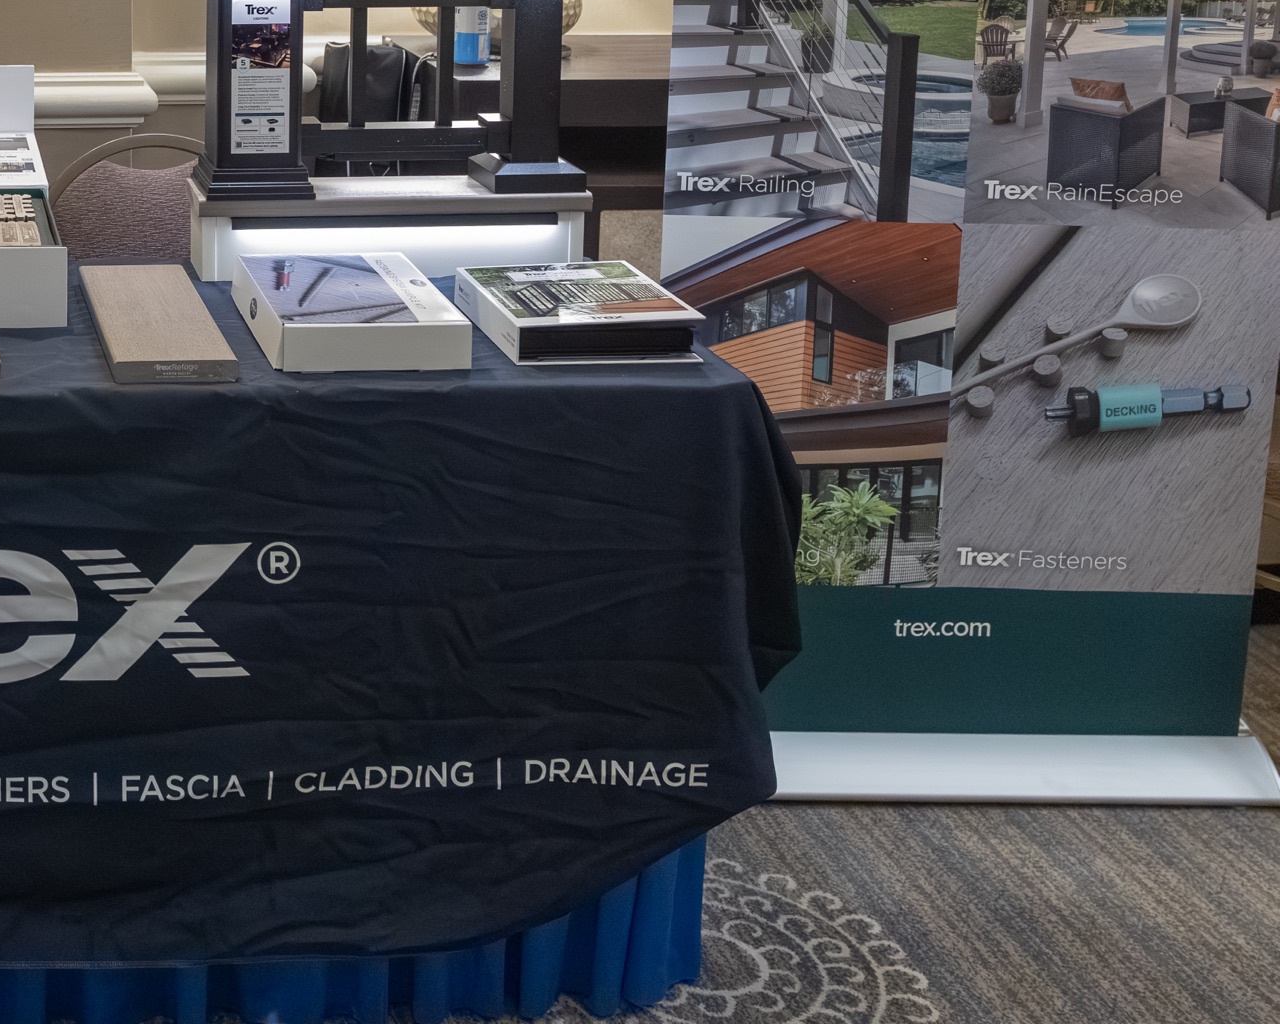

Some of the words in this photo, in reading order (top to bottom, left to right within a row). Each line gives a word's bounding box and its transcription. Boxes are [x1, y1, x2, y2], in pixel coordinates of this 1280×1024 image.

[245, 4, 274, 15] Trex
[740, 174, 816, 198] Railing
[1047, 182, 1183, 206] RainEscape
[1106, 404, 1157, 418] DECKING
[1019, 550, 1127, 570] Fasteners
[894, 619, 991, 637] trex.com
[121, 774, 245, 802] FASCIA
[294, 761, 474, 794] CLADDING
[524, 758, 709, 788] DRAINAGE
